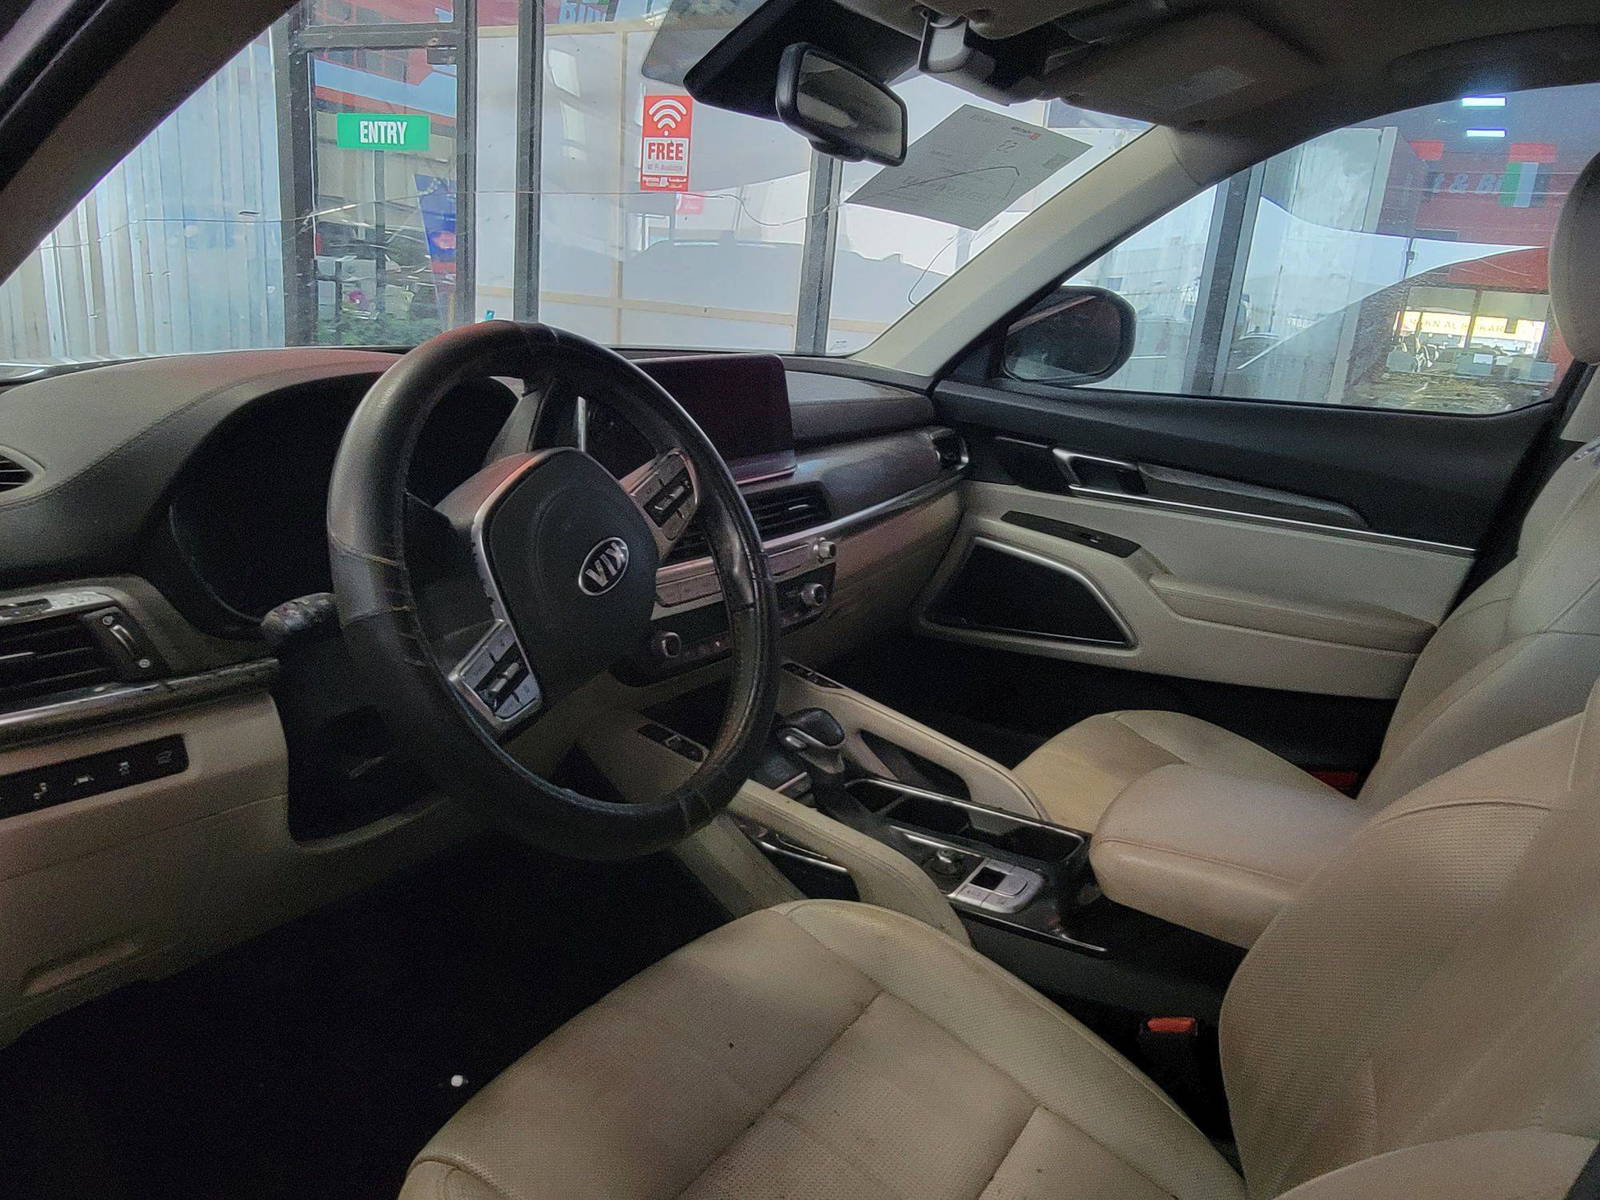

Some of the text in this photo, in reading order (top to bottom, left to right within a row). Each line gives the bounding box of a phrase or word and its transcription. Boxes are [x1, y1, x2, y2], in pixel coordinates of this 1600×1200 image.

[360, 120, 408, 145] ENTRY
[647, 142, 683, 161] FREE
[585, 542, 626, 587] KIA
